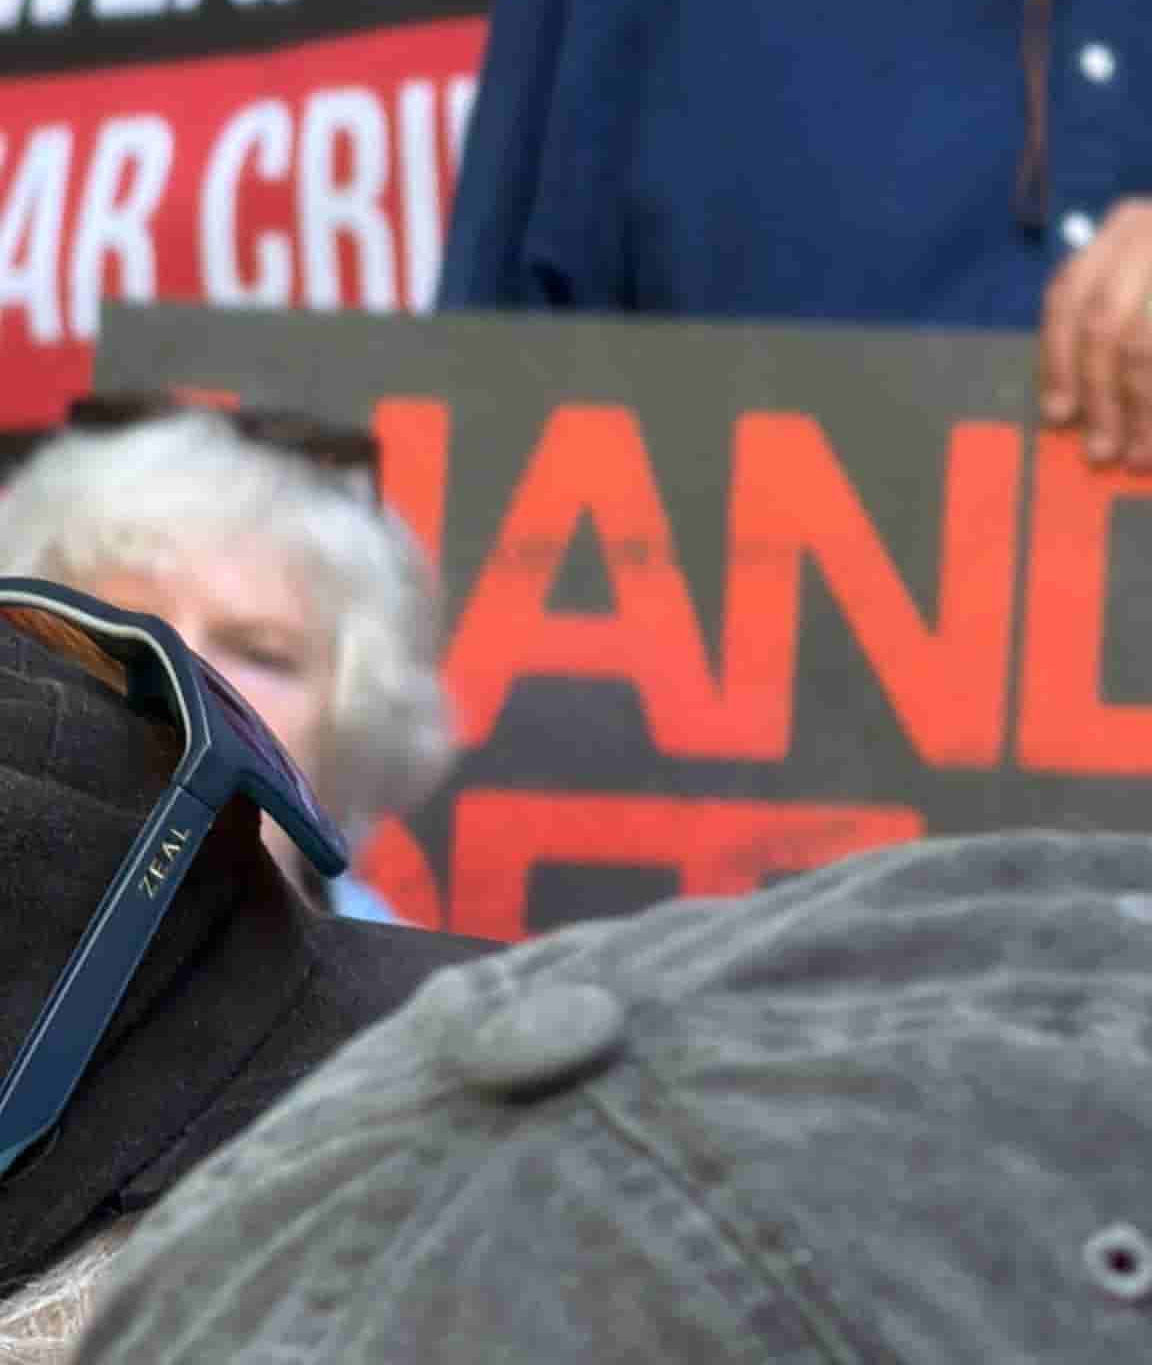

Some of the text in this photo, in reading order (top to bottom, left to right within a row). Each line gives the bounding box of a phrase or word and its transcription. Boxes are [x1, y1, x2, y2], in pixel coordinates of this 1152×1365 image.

[0, 76, 480, 346] AR CRI
[137, 826, 193, 899] ZEAL
